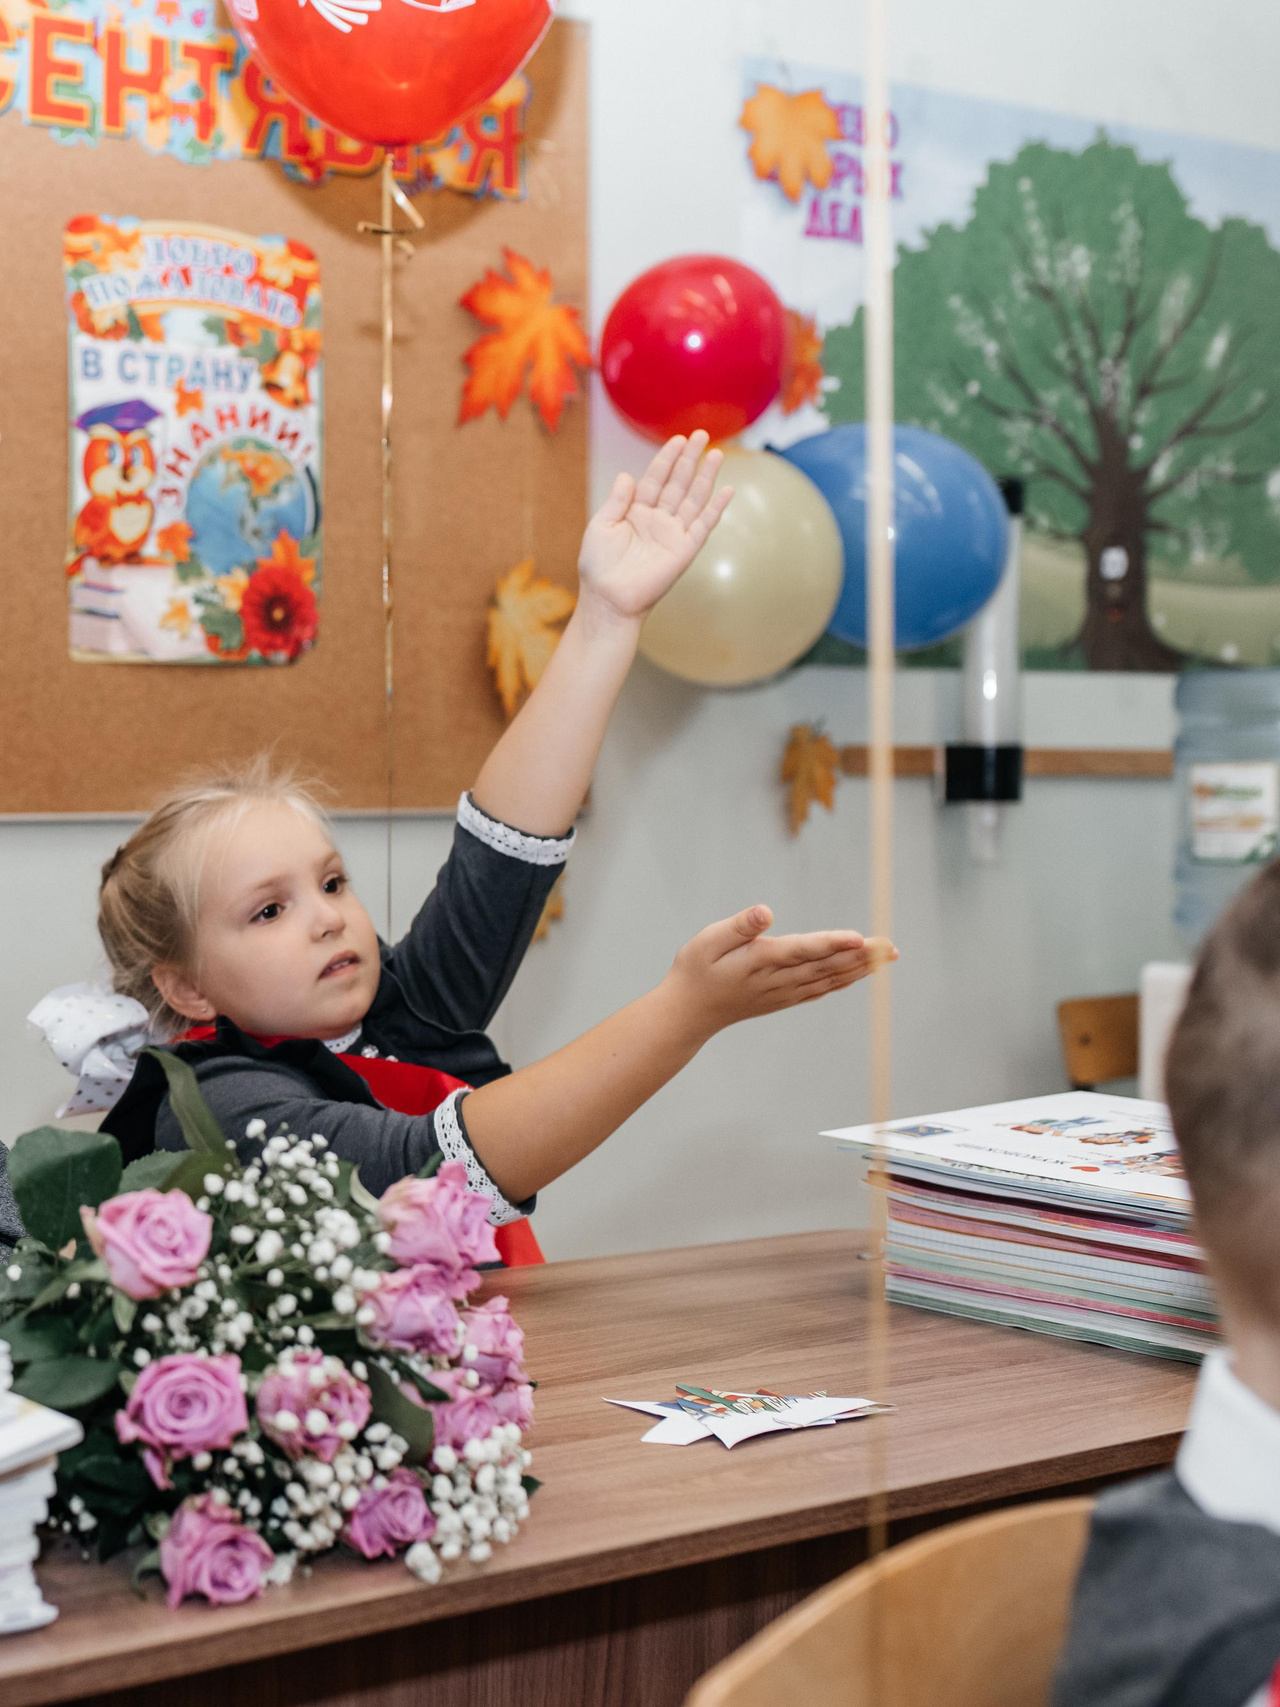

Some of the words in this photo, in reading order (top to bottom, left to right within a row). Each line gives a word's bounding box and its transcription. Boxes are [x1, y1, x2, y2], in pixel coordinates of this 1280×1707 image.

[144, 235, 258, 277] ДОБРО
[82, 269, 301, 327] ПОЖАЛОВАТЬ
[81, 349, 102, 380] В
[118, 351, 256, 394] СТРАНУ
